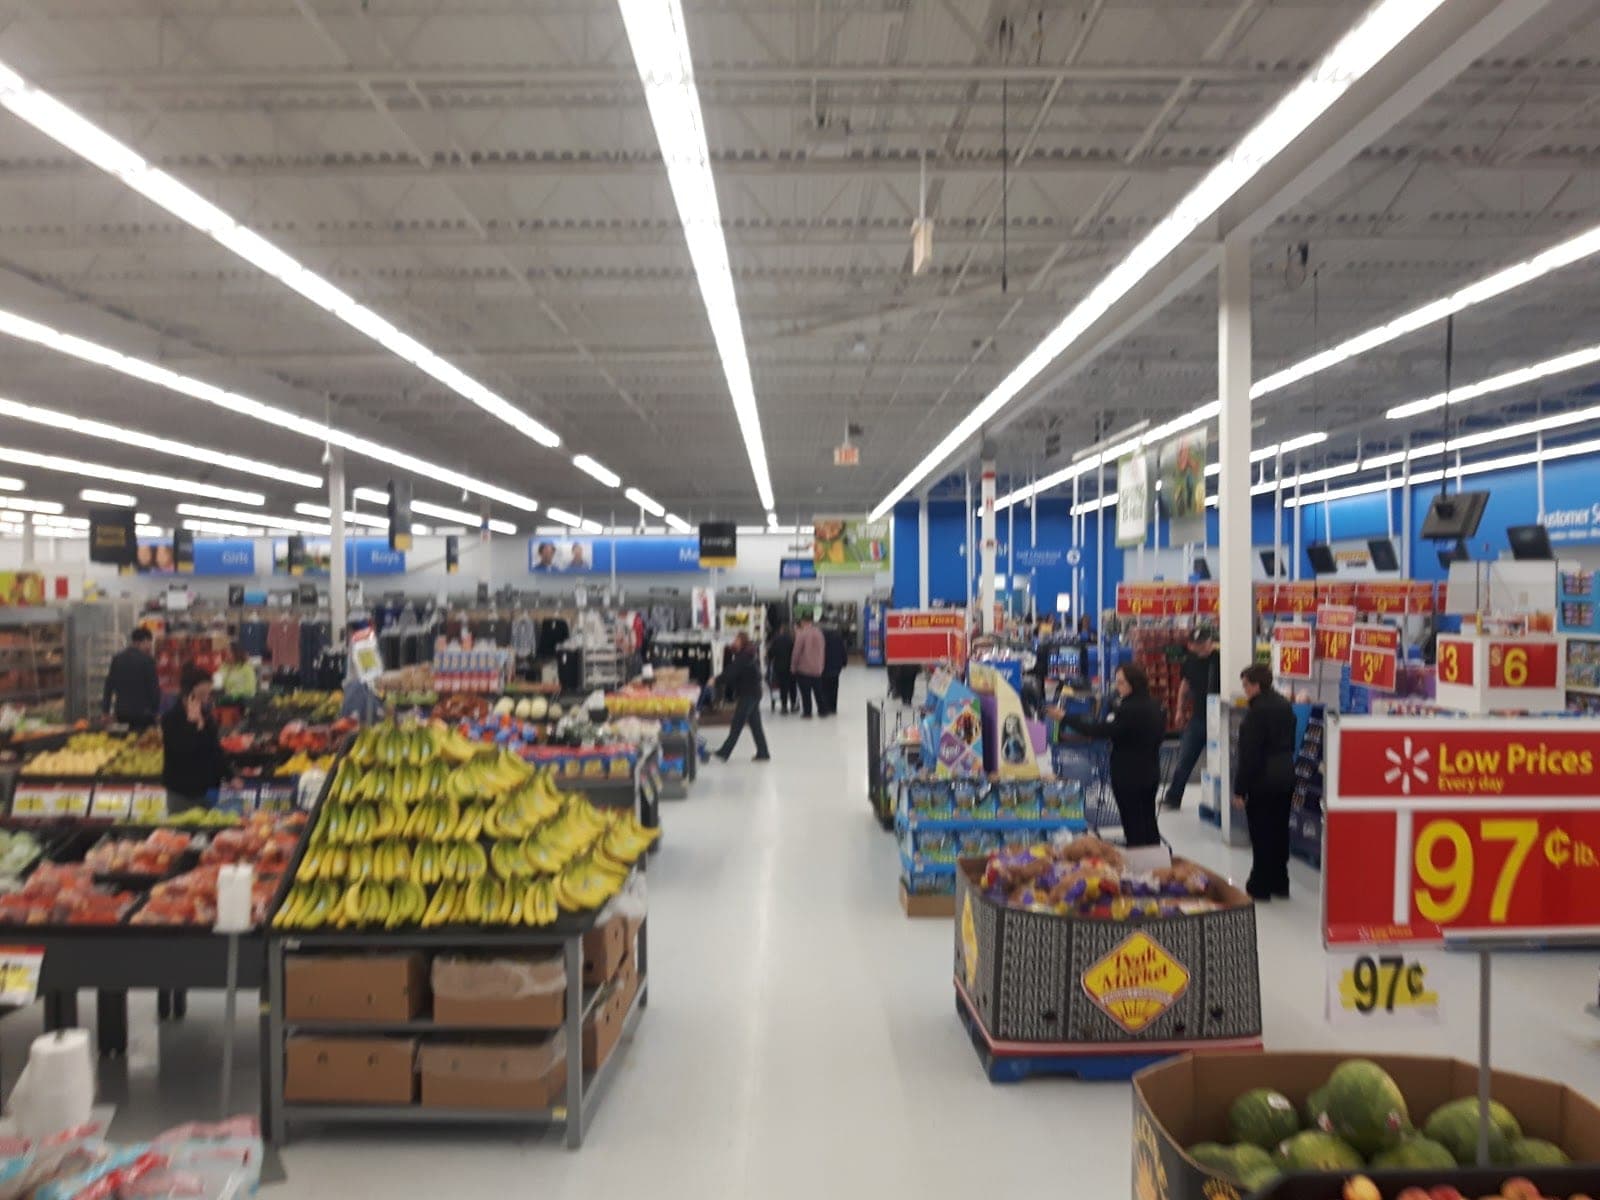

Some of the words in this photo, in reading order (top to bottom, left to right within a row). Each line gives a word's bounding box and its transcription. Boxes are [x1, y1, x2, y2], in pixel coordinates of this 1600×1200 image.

[1438, 743, 1500, 775] Low
[1507, 743, 1593, 775] Prices
[1438, 775, 1476, 793] Every
[1478, 776, 1504, 793] day
